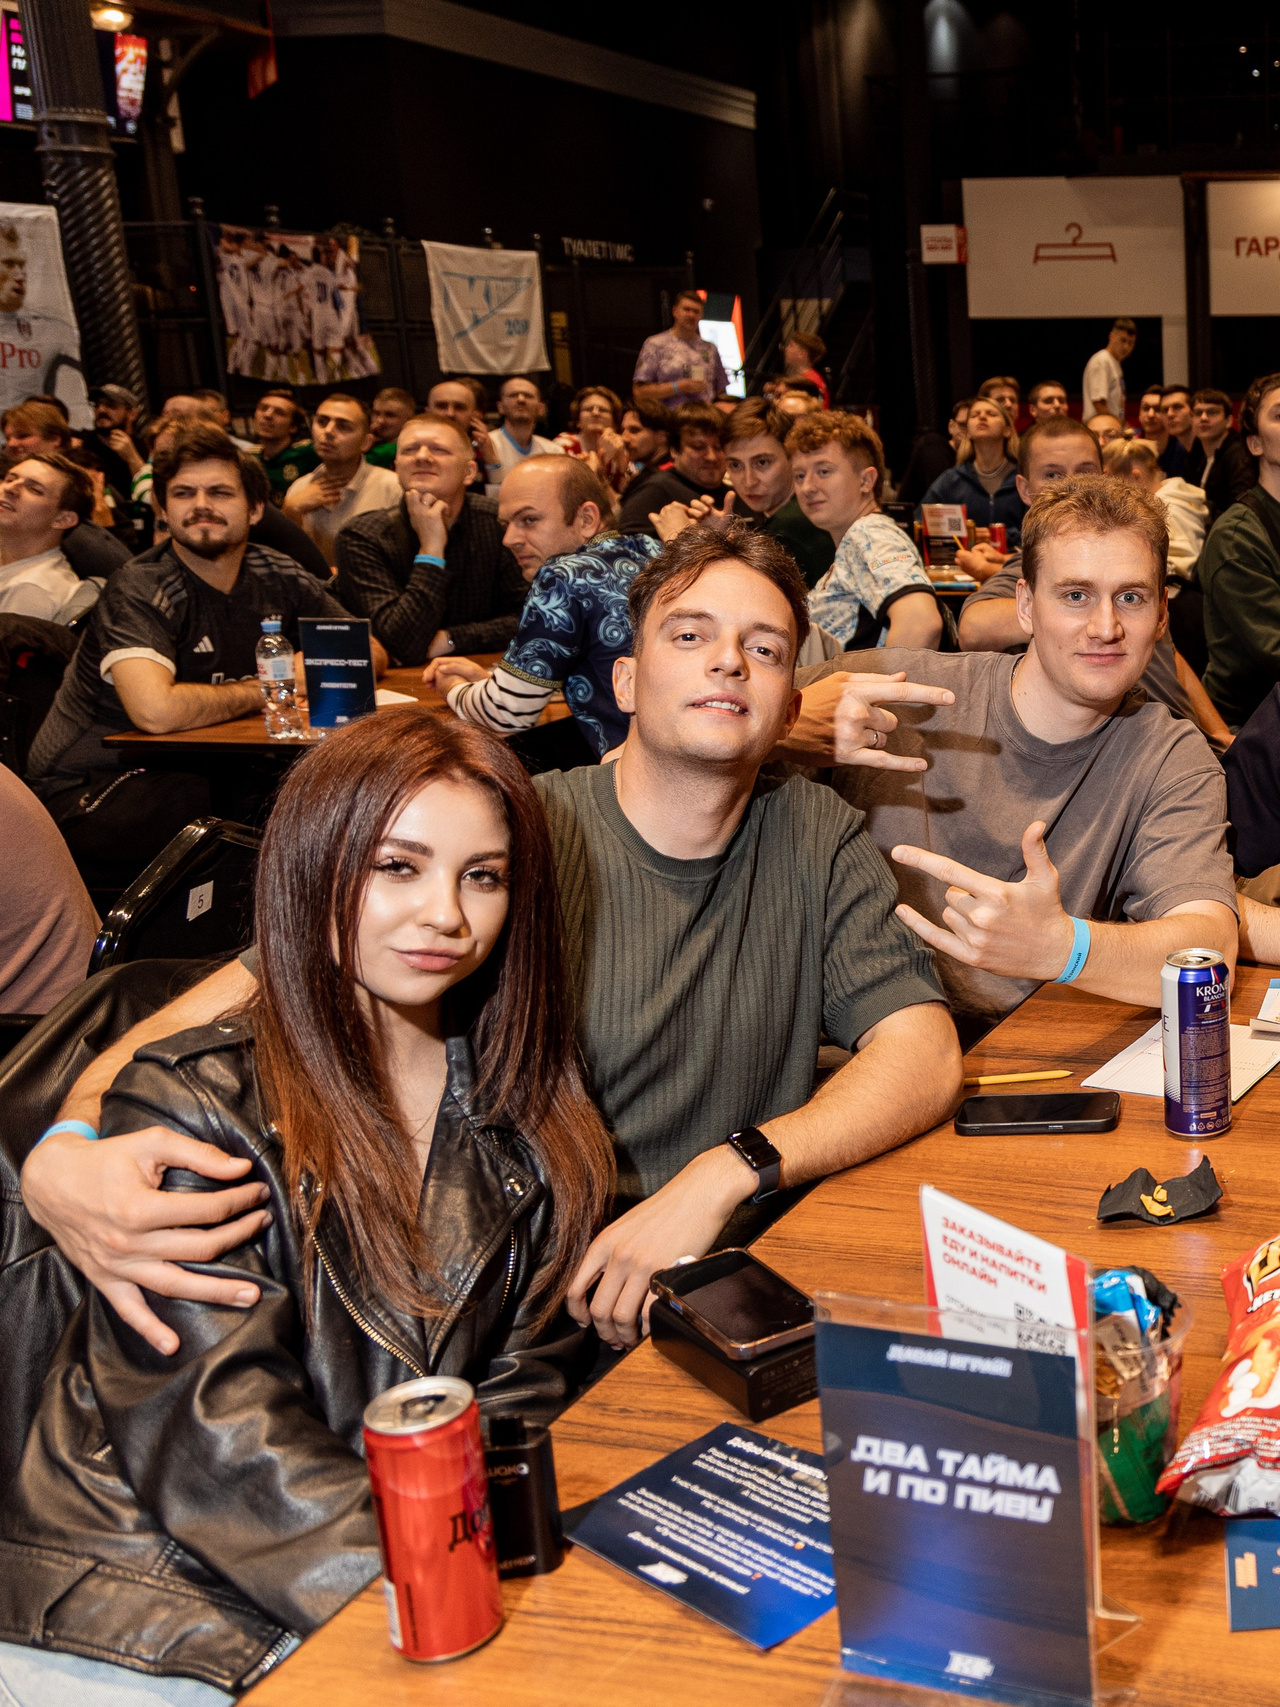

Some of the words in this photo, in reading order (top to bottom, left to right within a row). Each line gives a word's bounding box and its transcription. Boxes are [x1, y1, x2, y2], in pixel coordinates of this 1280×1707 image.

[197, 894, 205, 909] 5
[1196, 980, 1229, 997] KRONE
[941, 1215, 1042, 1275] ЗАКАЗЫВАЙТЕ
[941, 1234, 966, 1256] ЕДУ
[968, 1246, 979, 1262] И
[981, 1252, 1047, 1295] НАПИТКИ
[942, 1253, 999, 1288] ОНЛАЙН
[886, 1343, 948, 1368] ДАВАЙ
[850, 1434, 929, 1471] ДВА
[937, 1448, 1062, 1494] ТАЙМА
[863, 1467, 891, 1495] И
[896, 1476, 948, 1506] ПО
[955, 1485, 1055, 1523] ПИВУ
